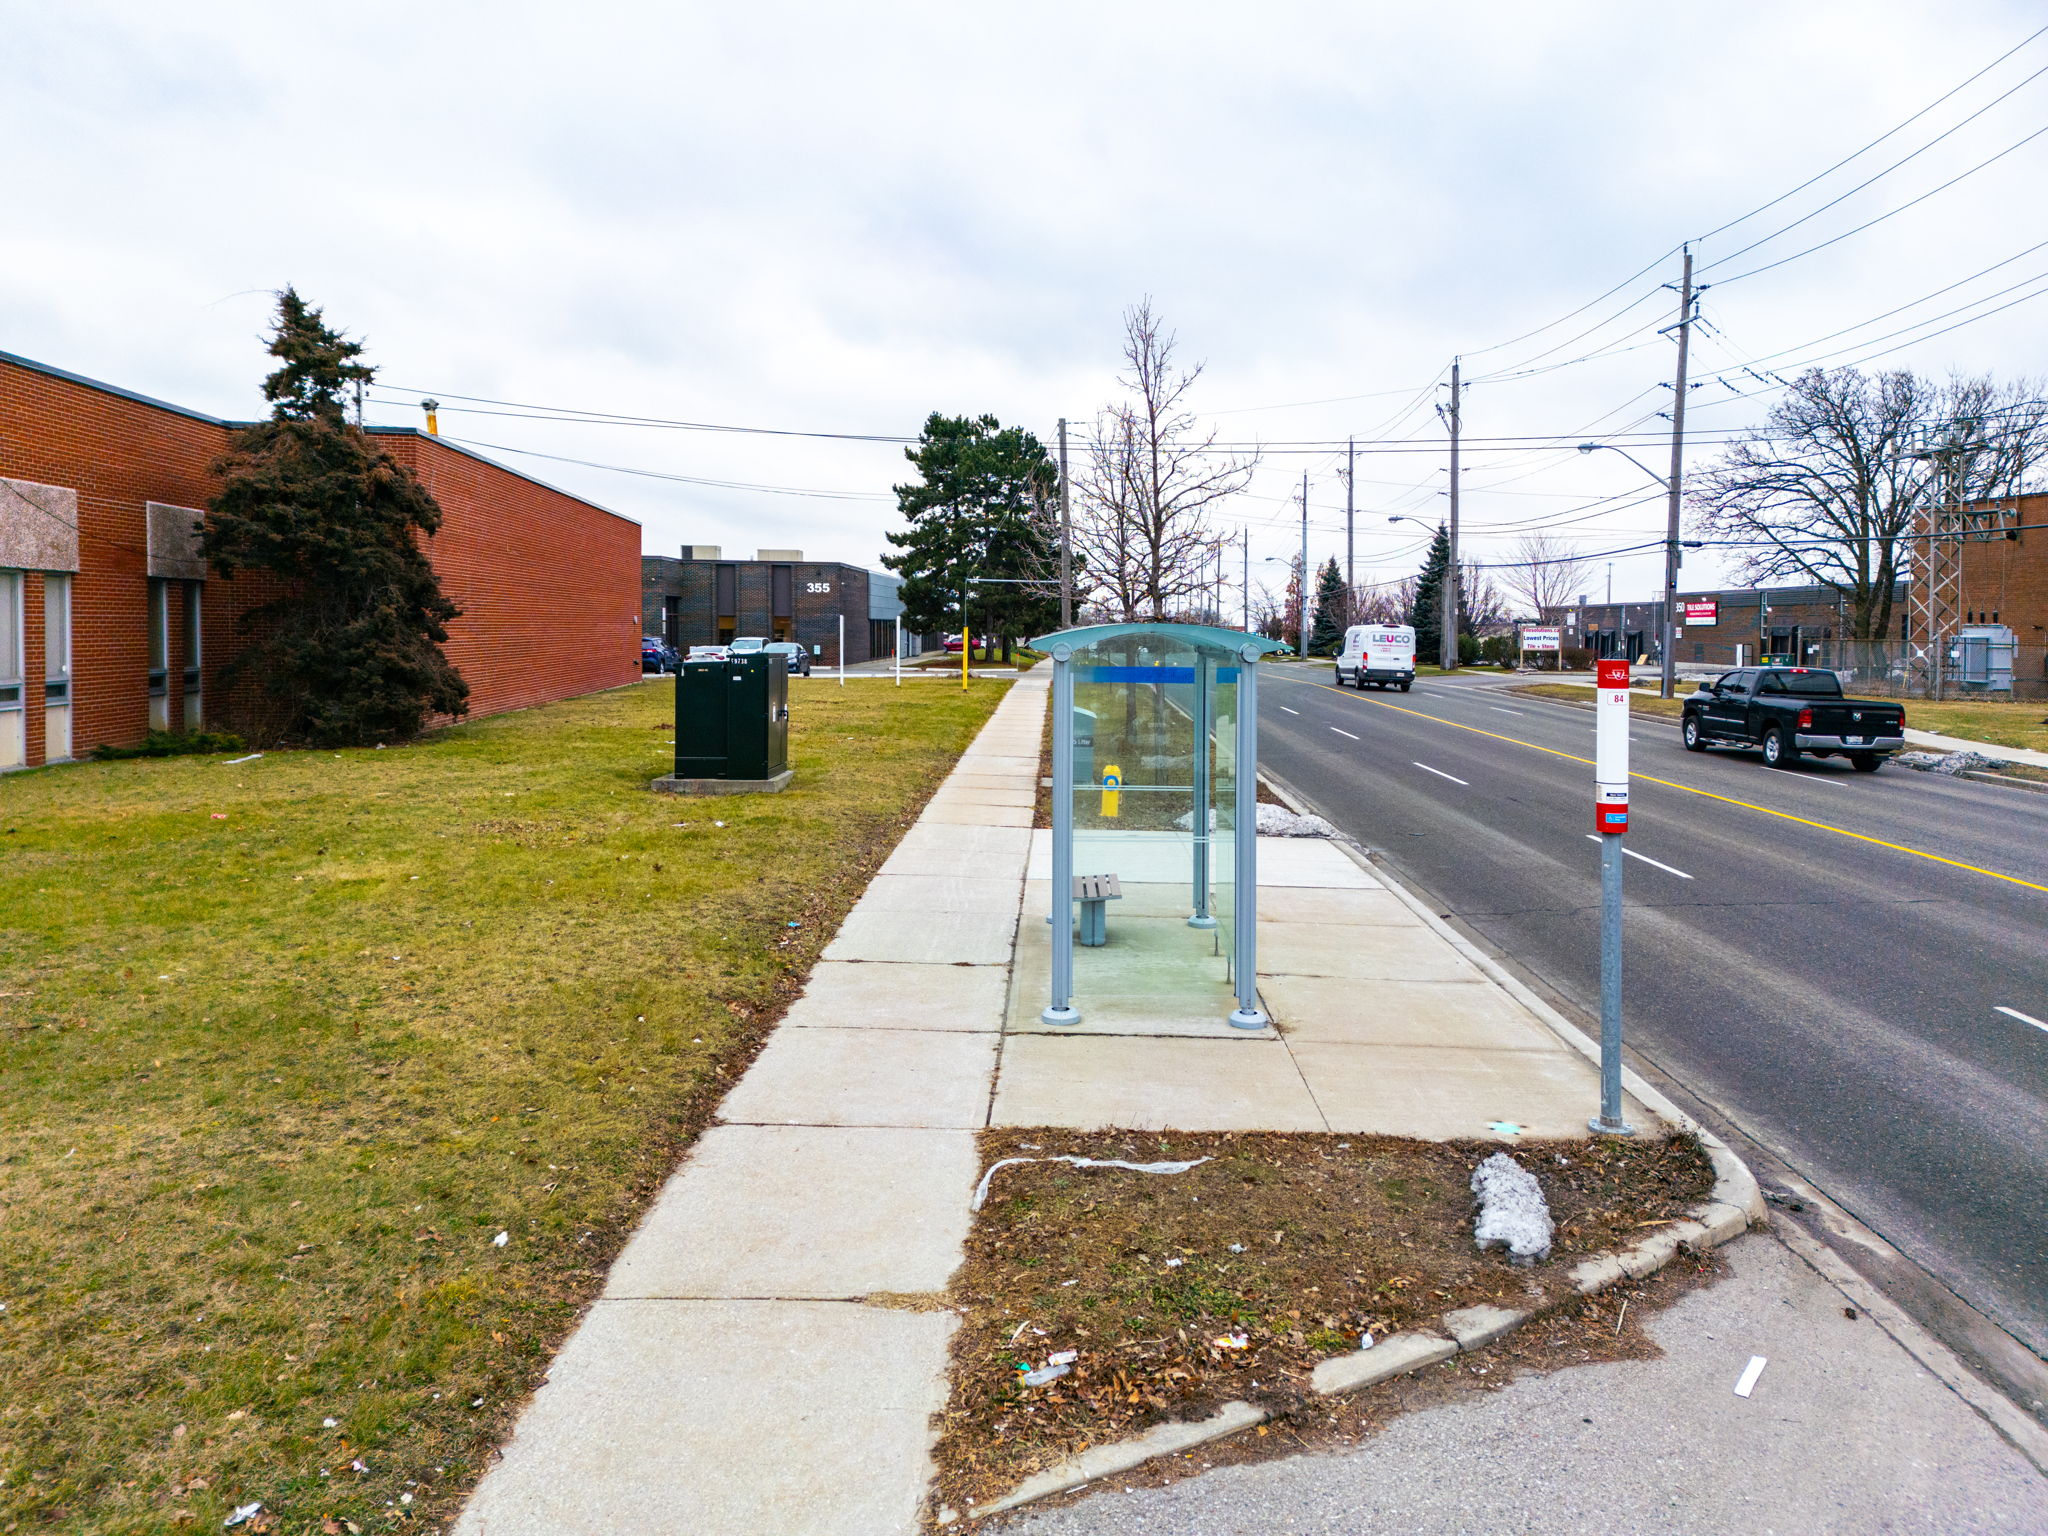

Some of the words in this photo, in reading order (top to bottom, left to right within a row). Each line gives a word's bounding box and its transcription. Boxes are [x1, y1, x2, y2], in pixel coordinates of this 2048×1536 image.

[806, 582, 831, 593] 355
[1675, 602, 1685, 613] 350
[1695, 603, 1716, 611] SOLUTIONS
[1372, 634, 1411, 644] LEUCO
[1613, 694, 1624, 703] 84
